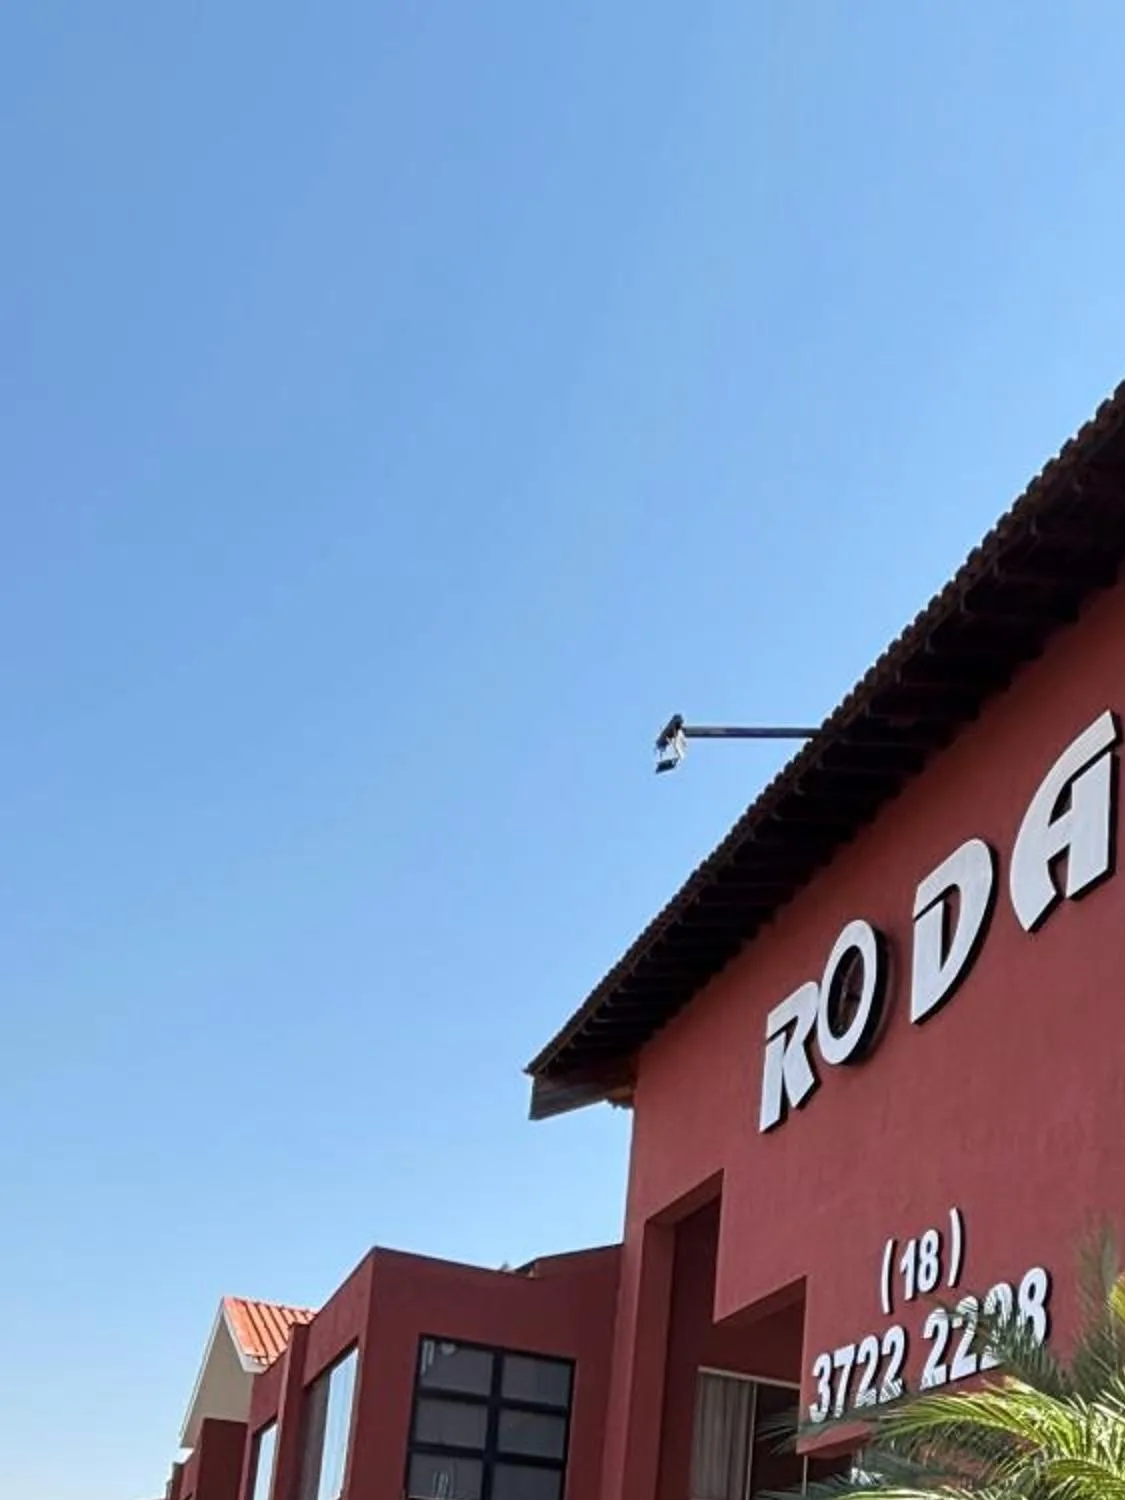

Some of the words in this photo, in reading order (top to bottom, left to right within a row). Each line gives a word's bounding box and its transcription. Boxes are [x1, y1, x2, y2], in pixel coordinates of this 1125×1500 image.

[758, 709, 1118, 1134] RODA
[881, 1206, 963, 1314] (18)
[809, 1324, 906, 1424] 3722
